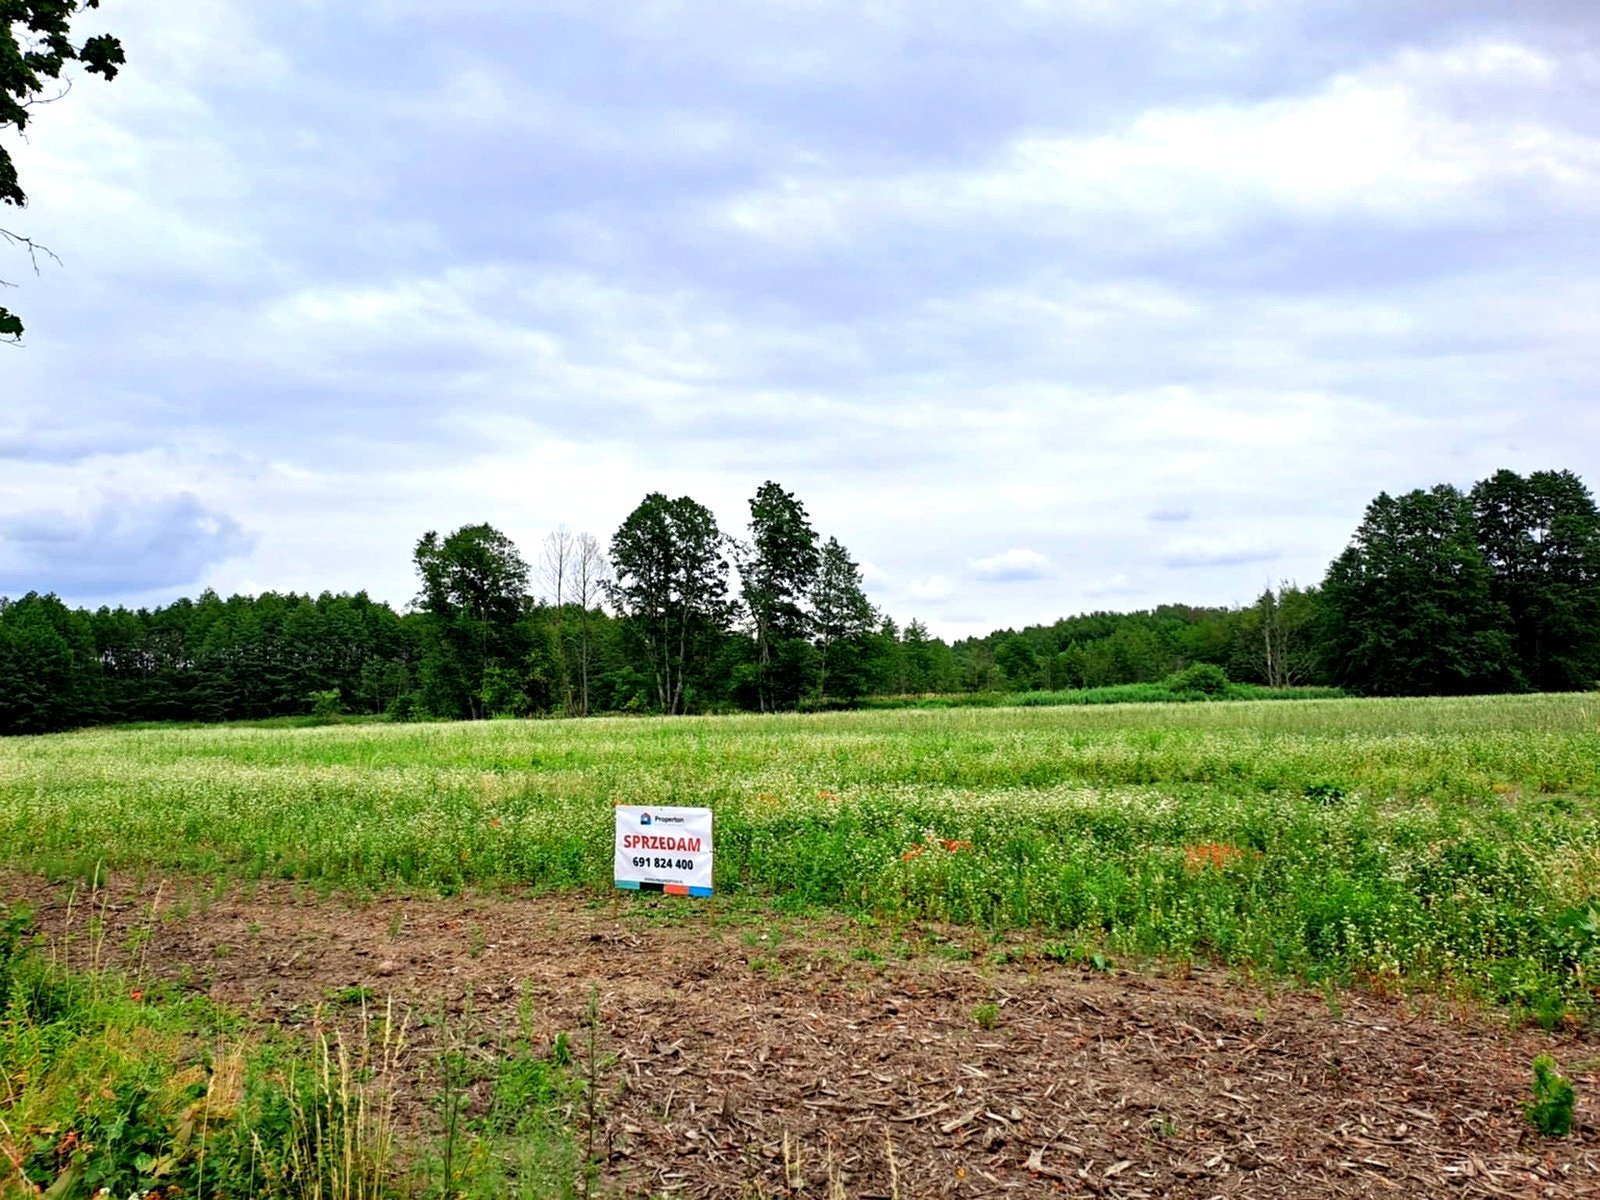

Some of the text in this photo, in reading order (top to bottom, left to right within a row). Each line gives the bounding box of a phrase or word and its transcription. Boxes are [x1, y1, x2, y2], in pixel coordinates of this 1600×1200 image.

[623, 835, 701, 852] SPRZEDAM
[632, 856, 693, 870] 691 824 400
